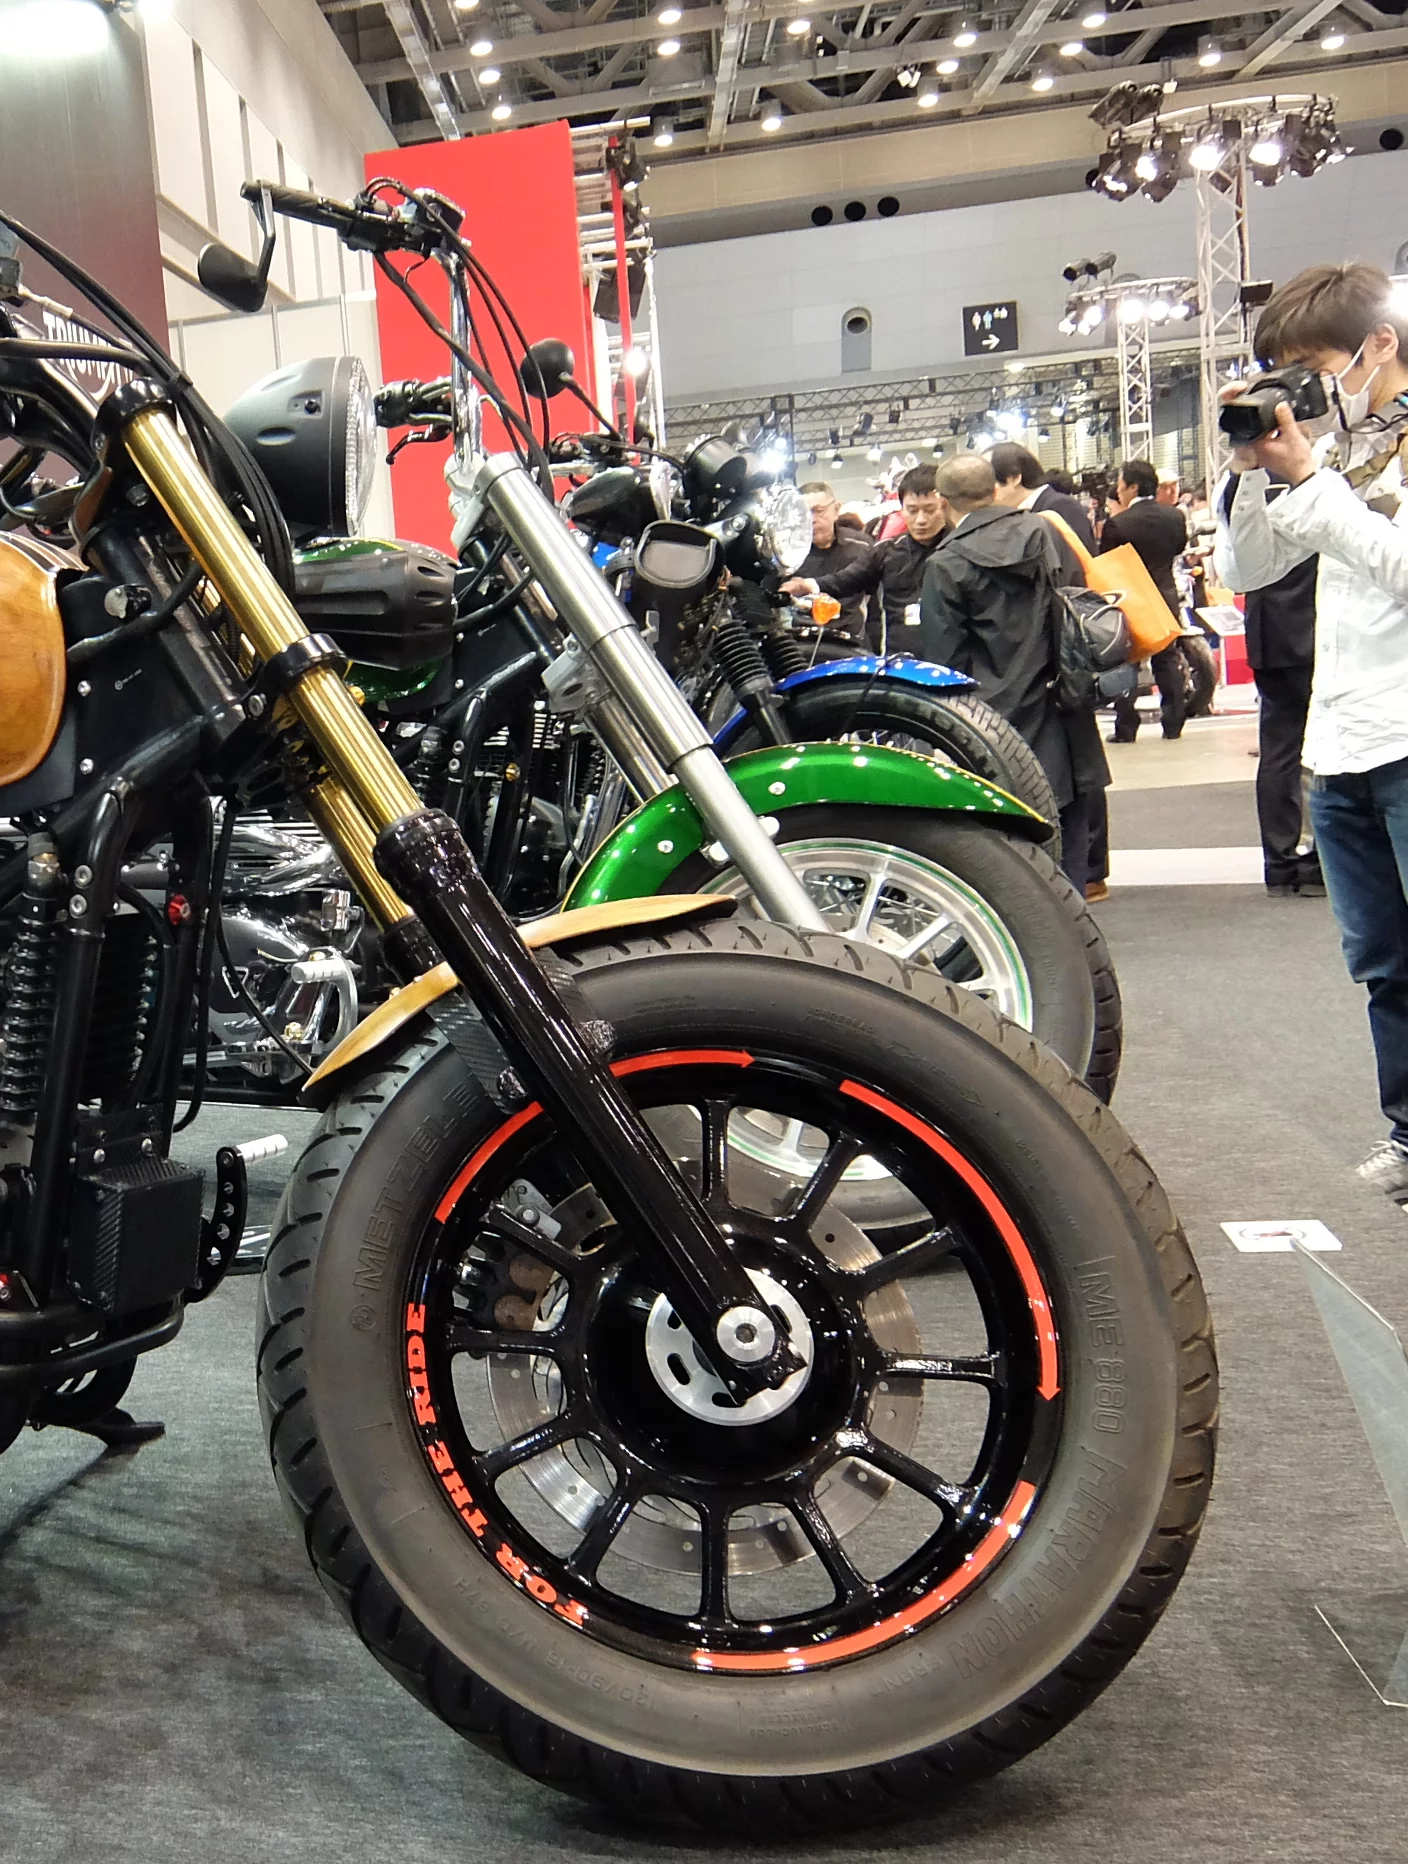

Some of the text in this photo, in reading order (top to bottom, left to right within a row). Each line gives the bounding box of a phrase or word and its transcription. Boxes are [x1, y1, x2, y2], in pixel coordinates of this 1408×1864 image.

[352, 1081, 482, 1292] METZELE
[1078, 1272, 1126, 1349] ME
[1092, 1358, 1128, 1436] 880
[406, 1302, 589, 1626] FOR THE RIDE
[946, 1446, 1129, 1681] MARATHON
